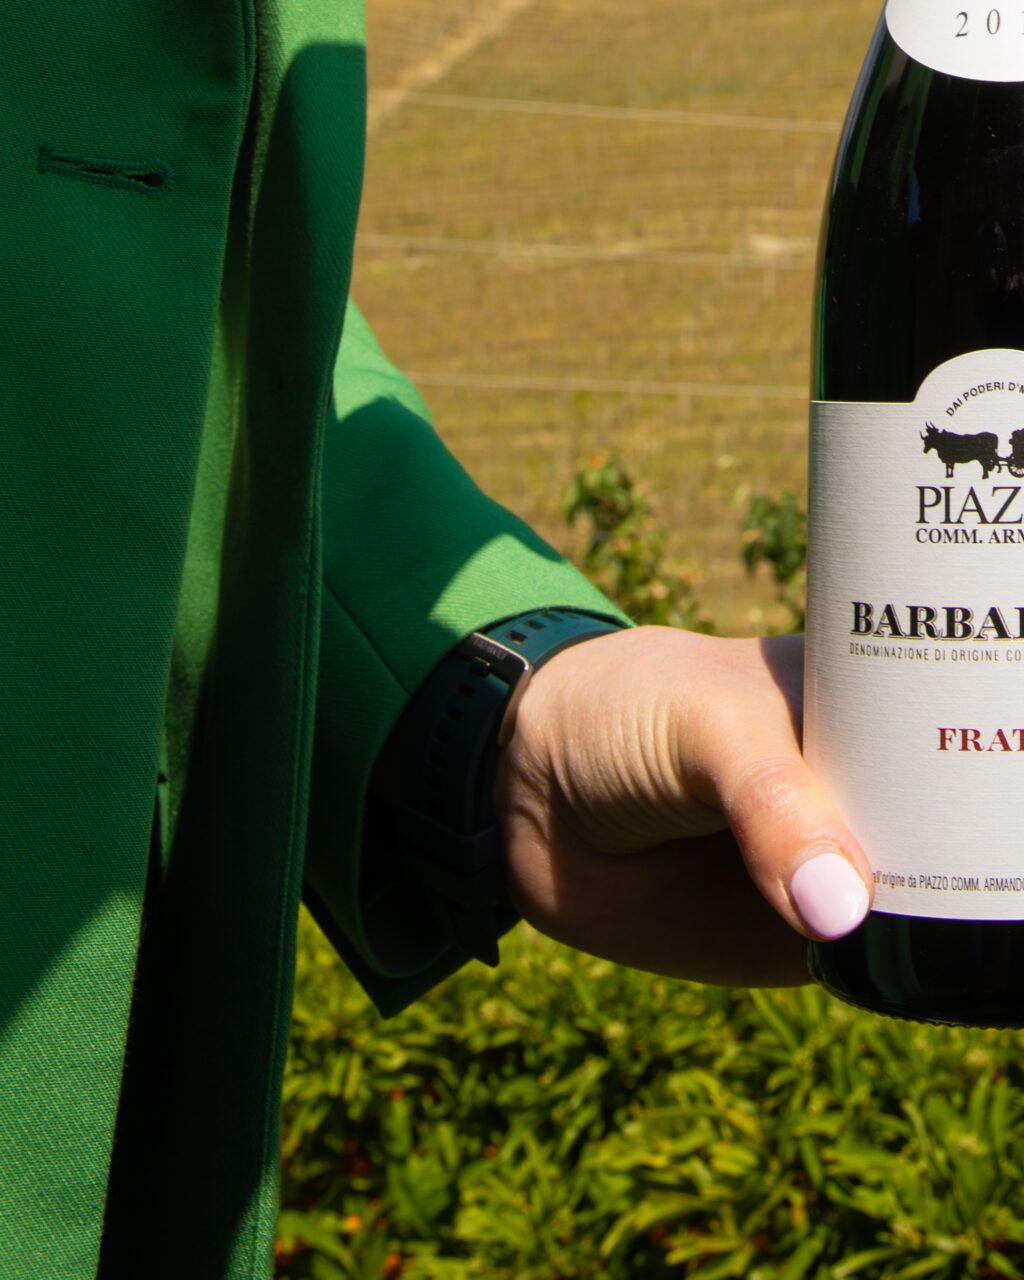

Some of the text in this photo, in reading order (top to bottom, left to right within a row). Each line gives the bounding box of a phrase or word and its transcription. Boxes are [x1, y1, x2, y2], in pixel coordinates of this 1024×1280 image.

[945, 398, 964, 416] DAI
[962, 381, 1005, 402] PODERI
[915, 528, 984, 544] COMM.
[849, 642, 929, 662] DENOMINAZIONE
[934, 648, 946, 661] DI
[951, 649, 1000, 662] ORIGINE
[908, 874, 917, 888] da
[919, 875, 949, 890] PIAZZO
[951, 876, 980, 892] COMM.
